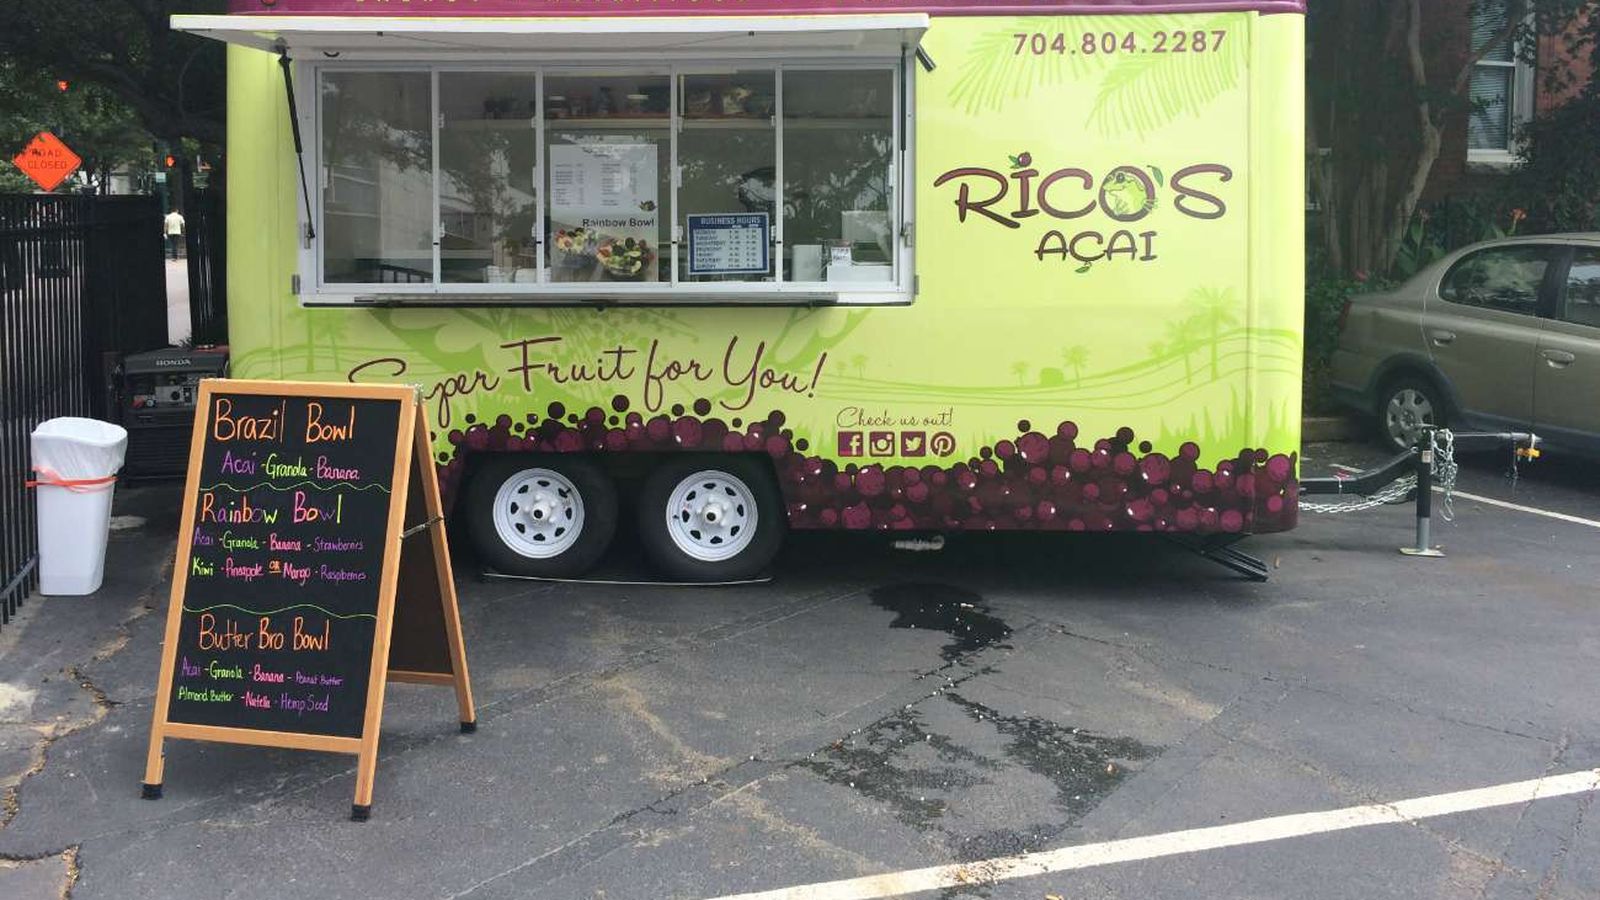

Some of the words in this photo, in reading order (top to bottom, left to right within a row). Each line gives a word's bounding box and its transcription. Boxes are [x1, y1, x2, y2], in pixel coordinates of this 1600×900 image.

[1013, 30, 1227, 56] 704.804.2287
[27, 160, 67, 170] CLOSED
[582, 218, 627, 228] Rainbow
[629, 217, 655, 228] Bowl
[737, 216, 761, 224] HOURS
[500, 336, 637, 392] Fruit
[643, 338, 713, 413] for
[699, 335, 828, 411] You!
[213, 398, 286, 442] Brazil
[305, 401, 356, 443] Bowl
[836, 406, 895, 428] Check
[899, 416, 919, 427] us
[922, 402, 954, 427] out!
[201, 492, 278, 524] Rainbow
[293, 491, 343, 525] Bowl
[270, 532, 302, 552] Banana
[192, 556, 214, 577] Kiwi
[225, 556, 265, 582] Pineapple
[282, 561, 312, 587] Mango
[199, 613, 253, 651] Butter
[258, 616, 285, 650] Bro
[293, 616, 330, 651] Bowl
[252, 663, 285, 683] Banana
